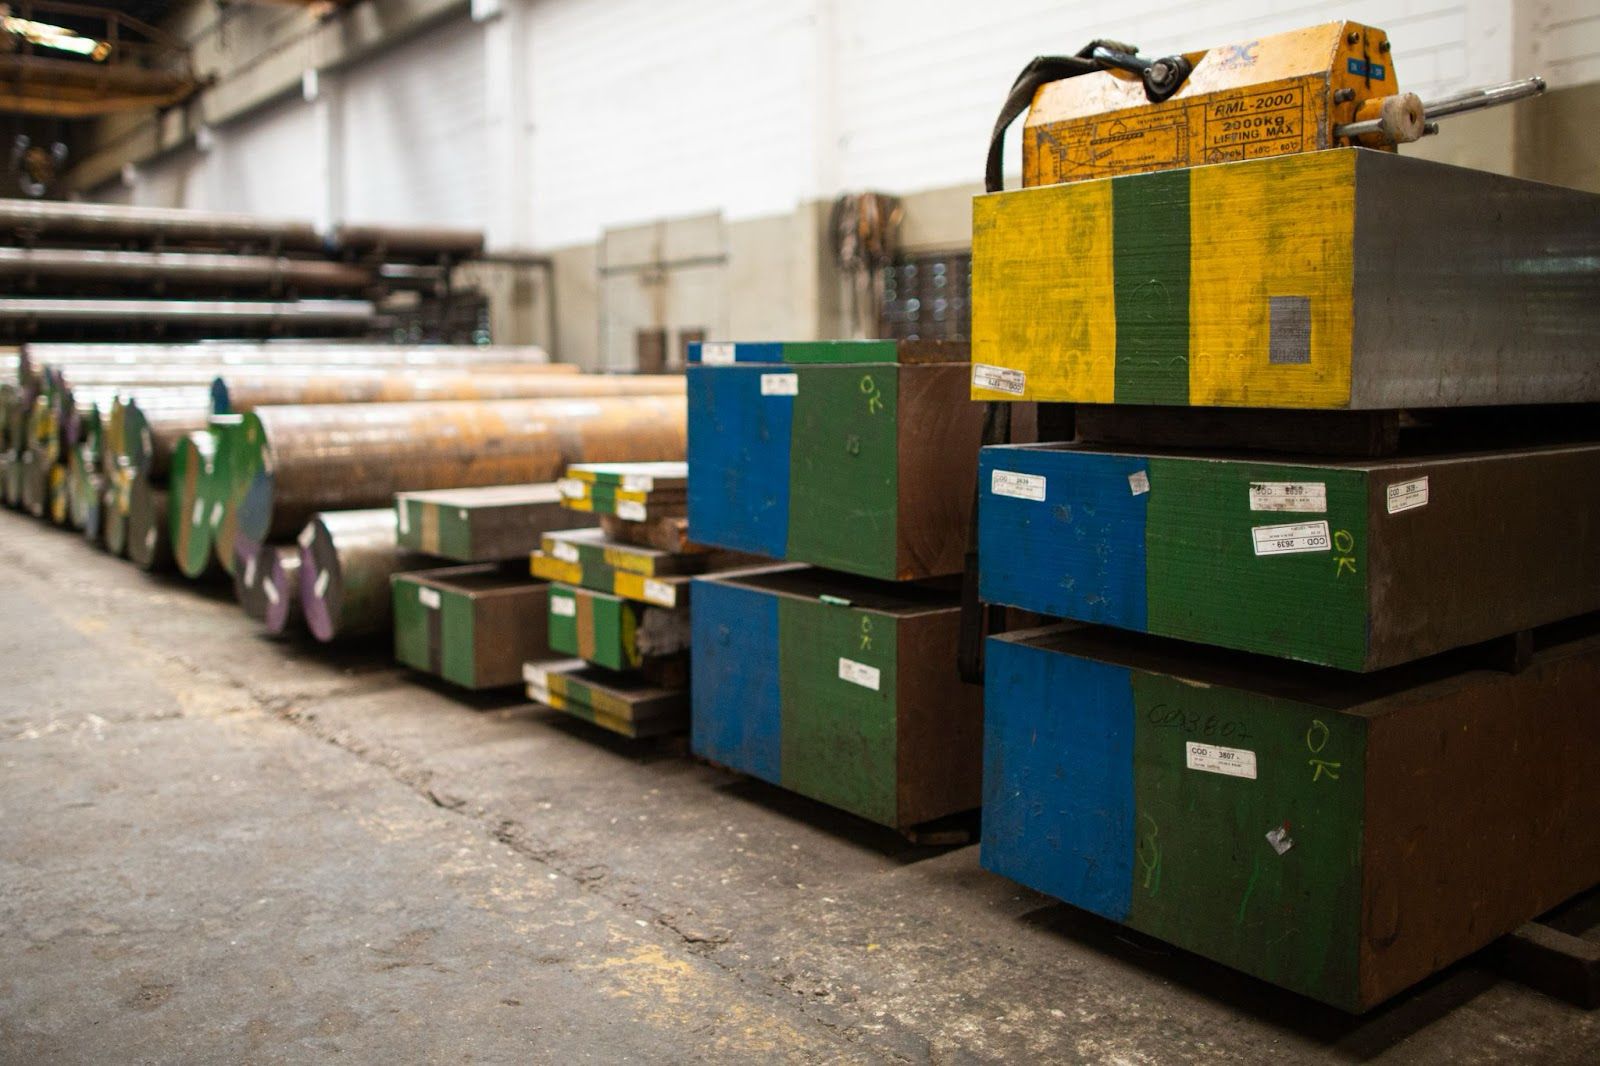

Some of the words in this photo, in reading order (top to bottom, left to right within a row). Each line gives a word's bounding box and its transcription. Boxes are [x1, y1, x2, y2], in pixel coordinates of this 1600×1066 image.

[1213, 130, 1259, 144] LIFTING
[1266, 125, 1293, 137] MAX
[860, 374, 884, 415] OK
[1333, 529, 1357, 578] OK
[1218, 751, 1235, 760] 3807
[1306, 719, 1341, 782] OK
